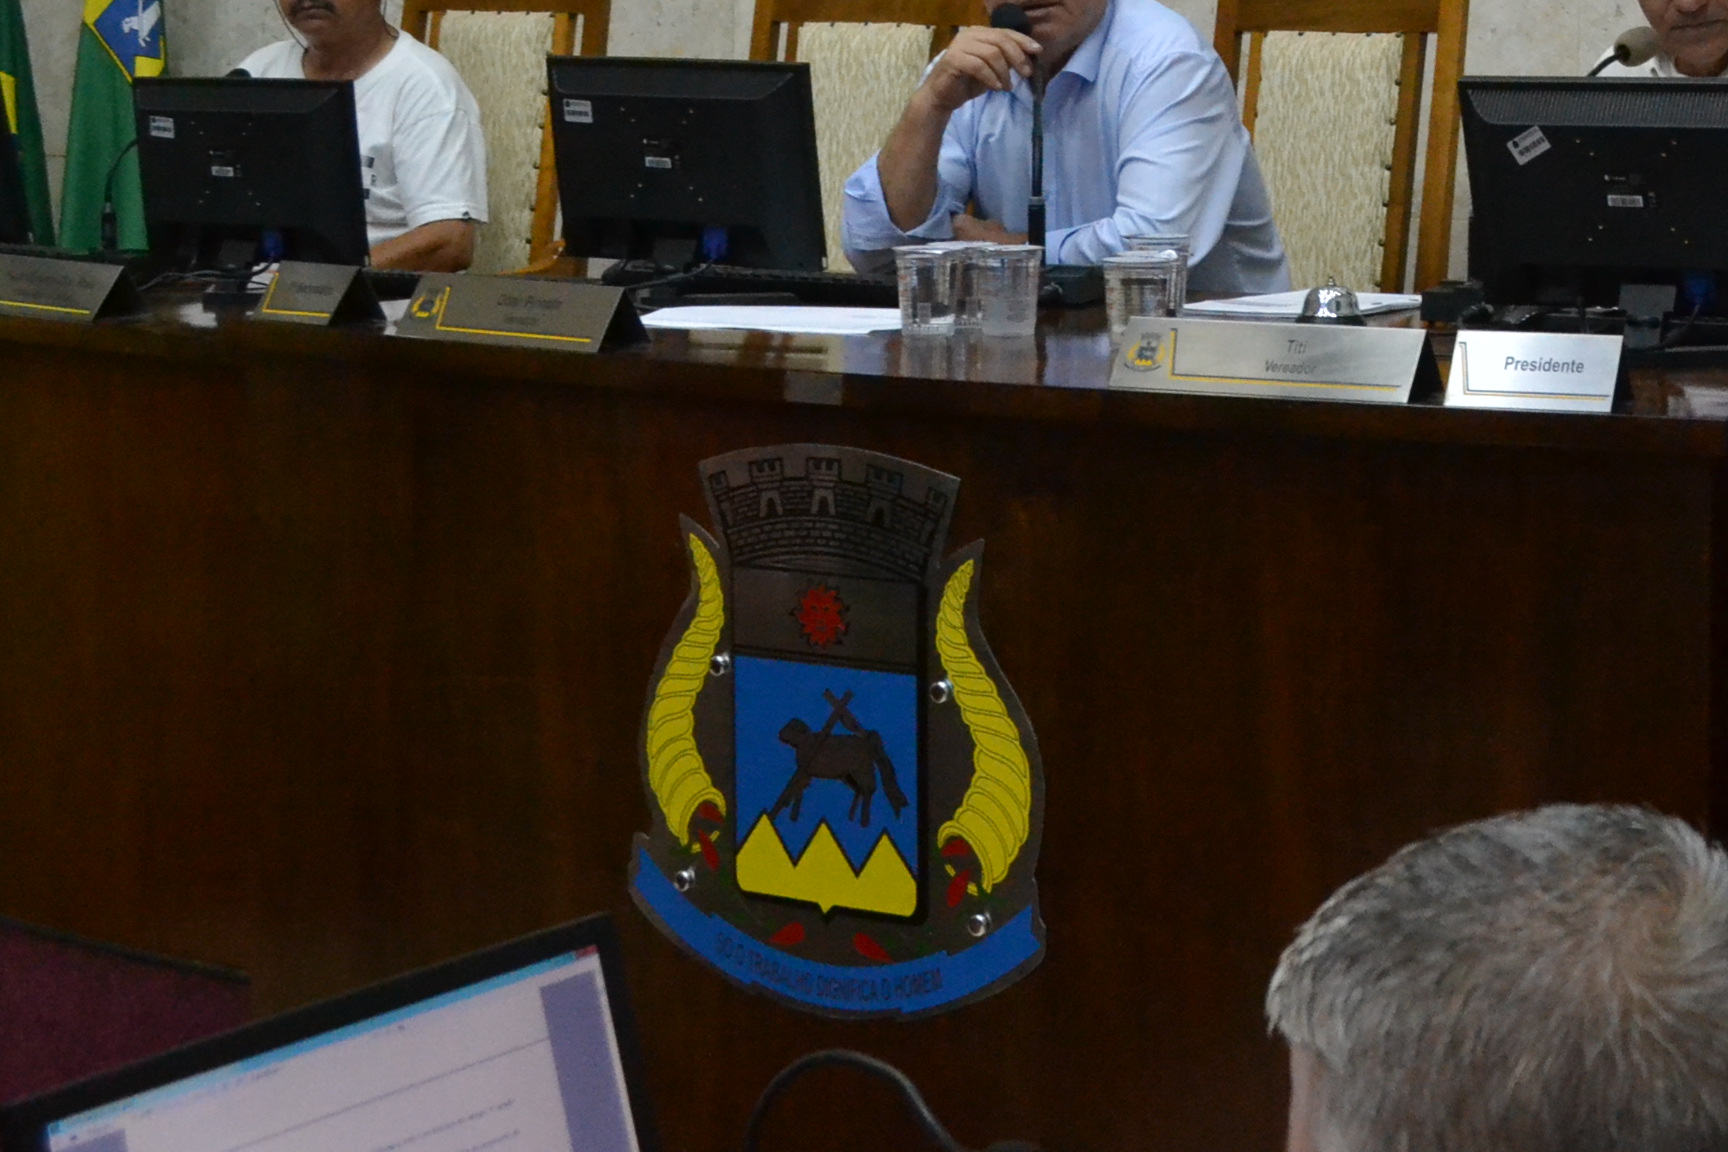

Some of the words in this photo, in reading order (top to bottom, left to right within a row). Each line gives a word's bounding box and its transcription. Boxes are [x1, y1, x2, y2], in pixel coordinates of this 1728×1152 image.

[1287, 339, 1307, 354] Titi
[1264, 360, 1317, 374] Vereador
[1503, 356, 1585, 374] Presidente
